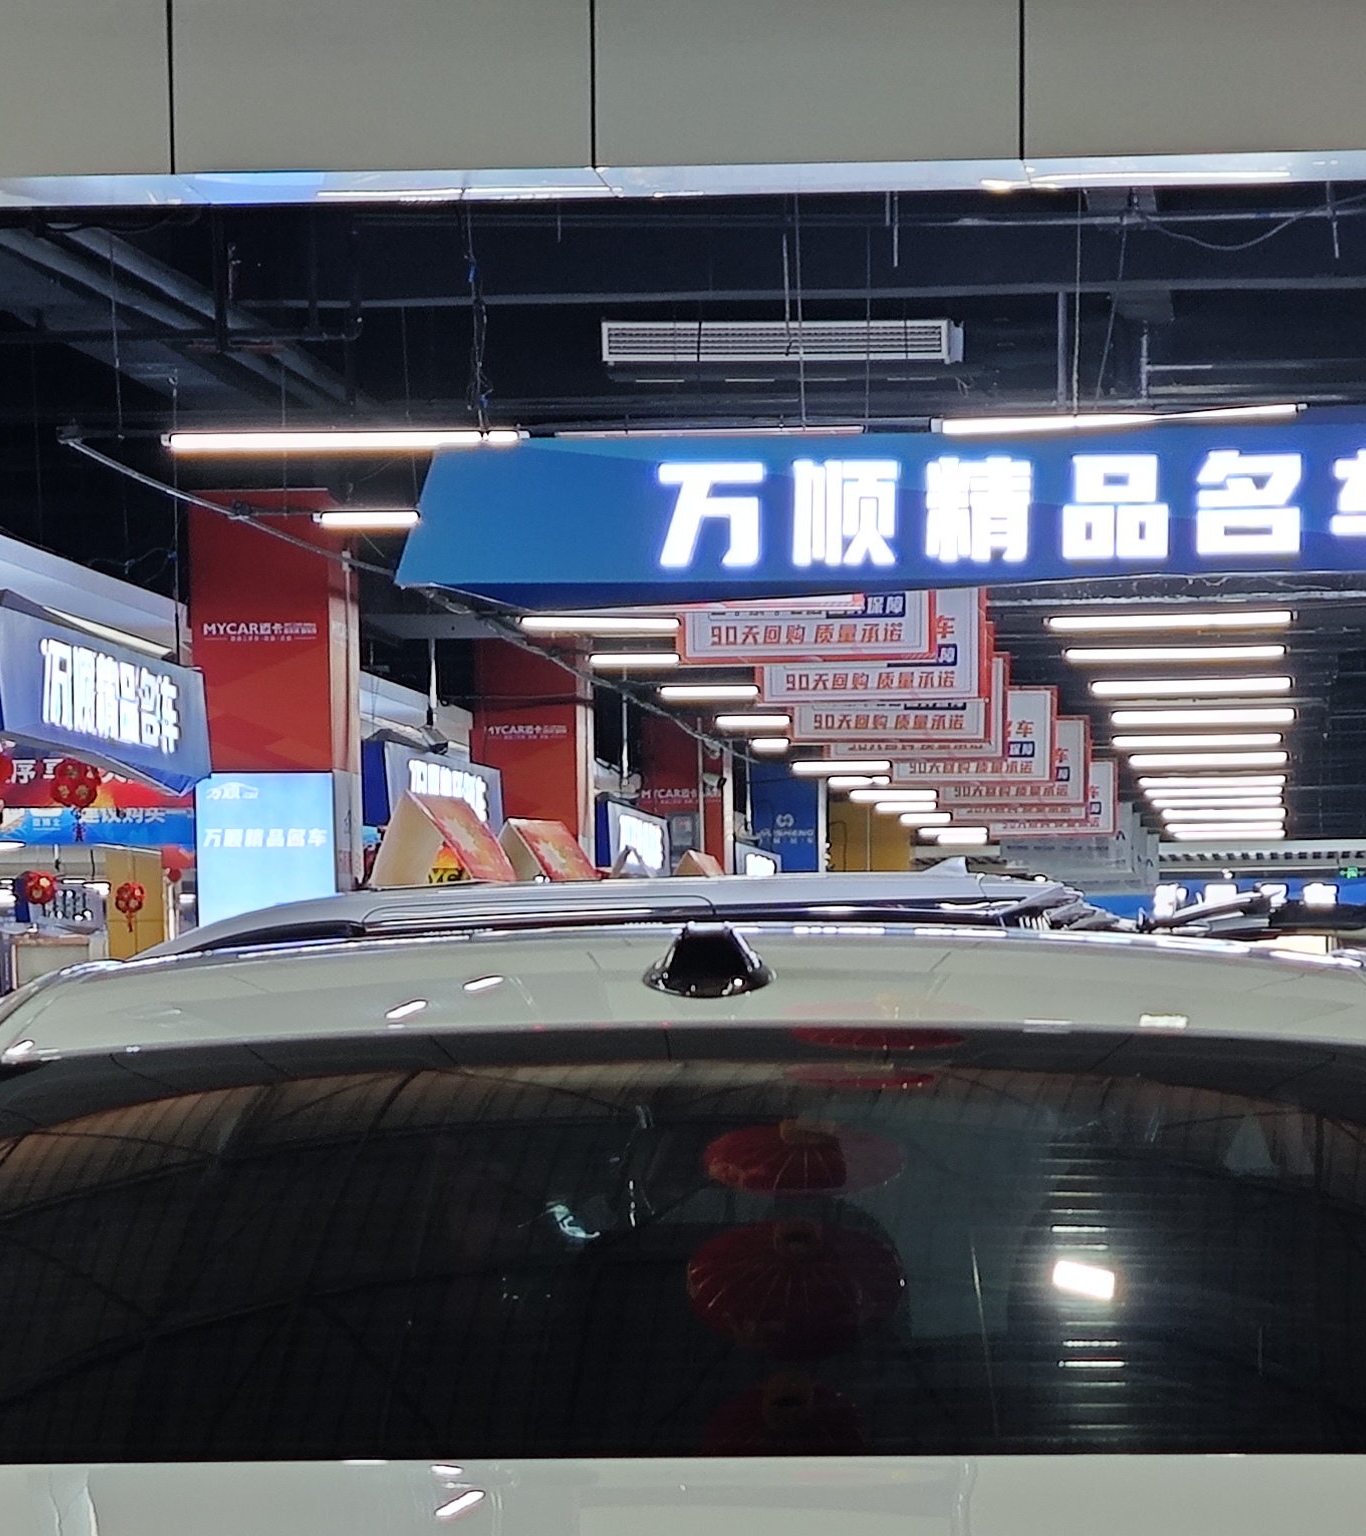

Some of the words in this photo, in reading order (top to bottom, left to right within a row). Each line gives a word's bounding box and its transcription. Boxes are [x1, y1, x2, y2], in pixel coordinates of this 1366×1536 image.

[710, 623, 806, 647] 90天回购
[814, 621, 904, 645] 质量承诺
[785, 672, 870, 691] 90天回购
[876, 671, 956, 689] 质量承诺
[813, 714, 888, 730] 90天回购
[894, 713, 966, 730] 质量承诺
